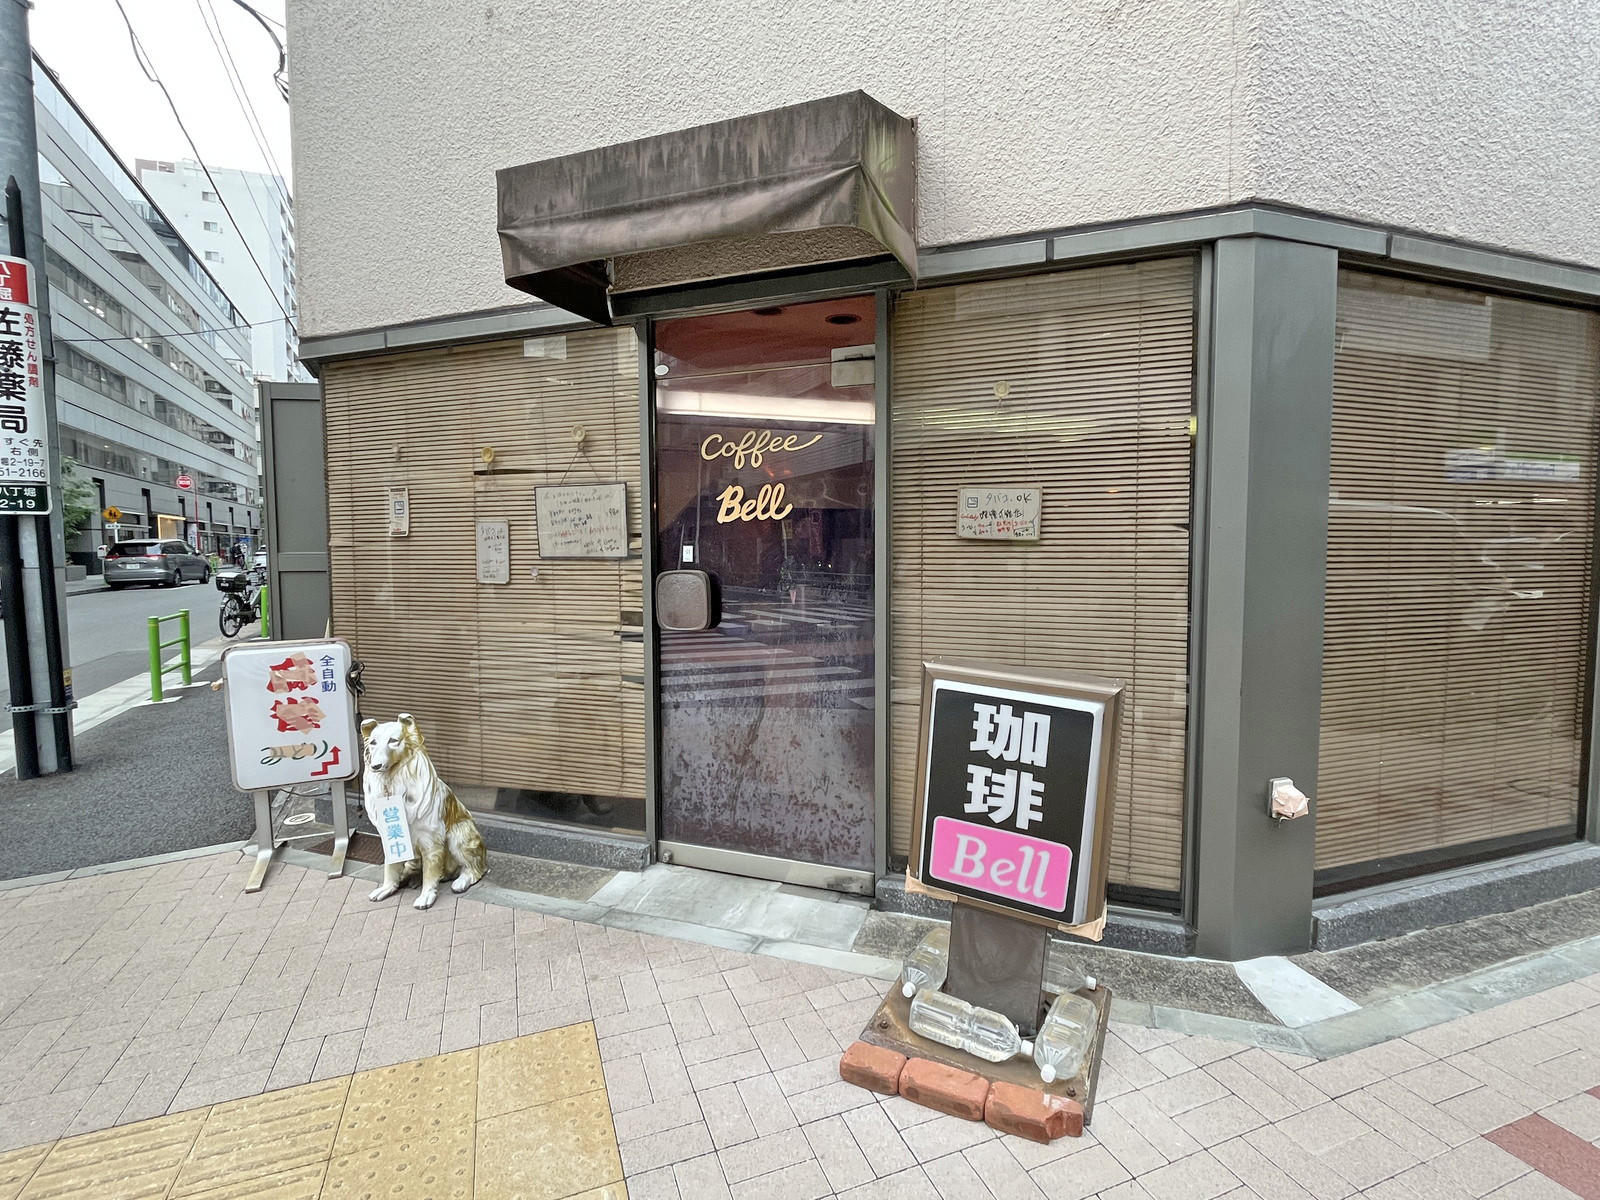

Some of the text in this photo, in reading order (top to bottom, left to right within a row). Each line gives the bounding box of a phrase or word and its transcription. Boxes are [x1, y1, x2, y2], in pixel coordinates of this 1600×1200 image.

[10, 447, 39, 457] 右側
[701, 430, 823, 470] Coffee
[716, 483, 793, 524] Bell
[320, 654, 337, 693] 全自動
[963, 702, 1051, 830] 珈琲
[382, 806, 407, 858] 営業中
[949, 832, 1051, 899] Bell
